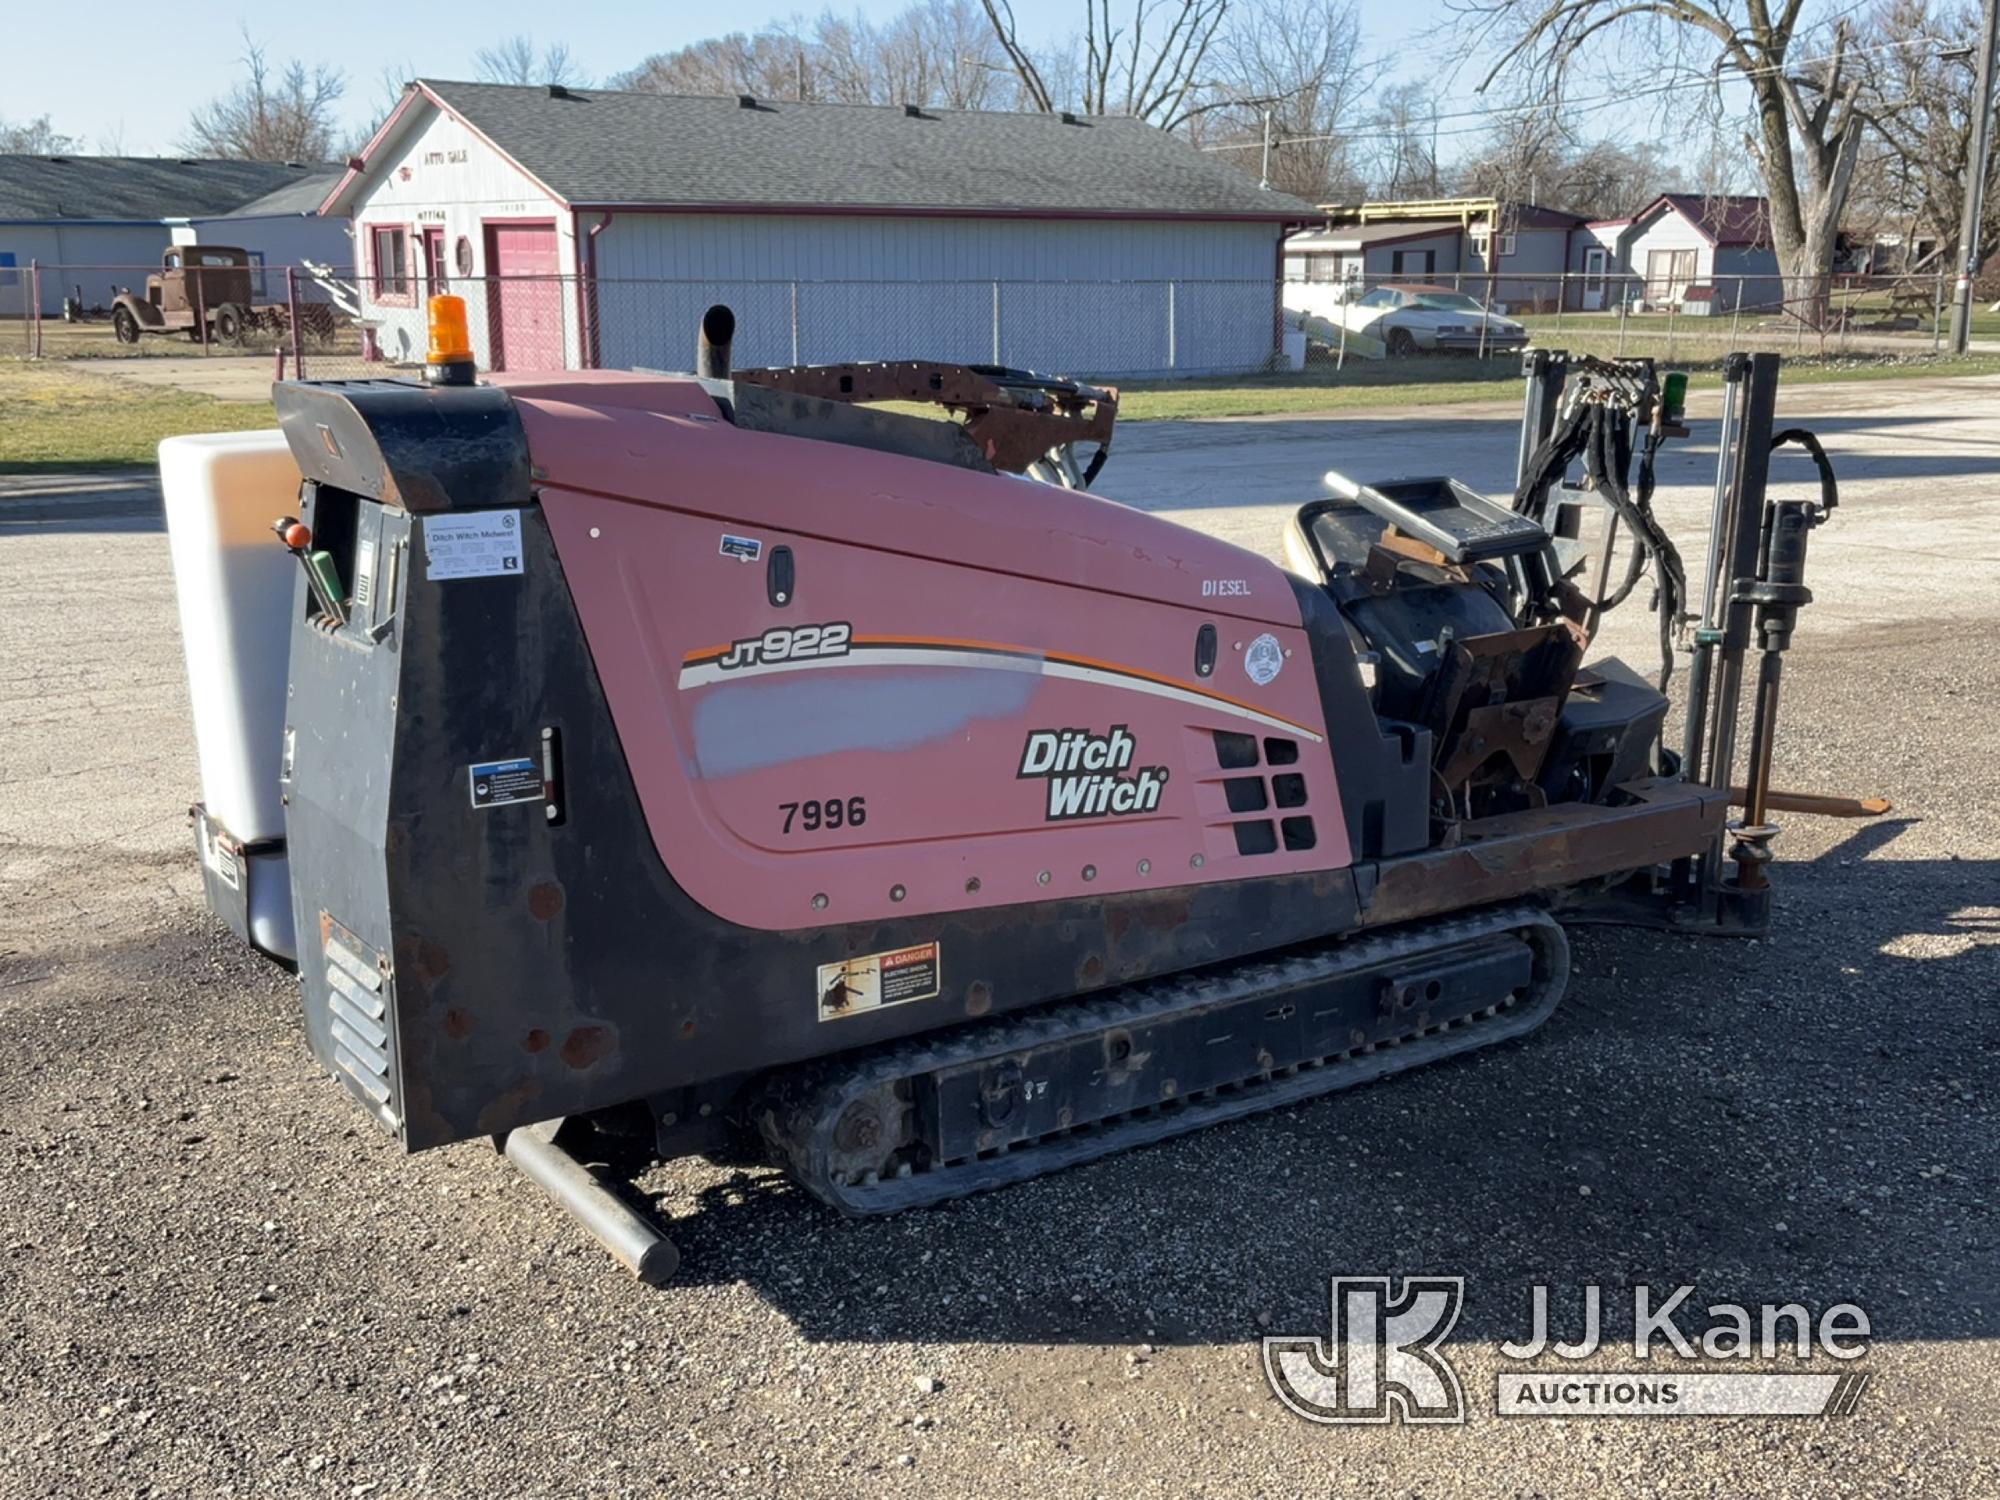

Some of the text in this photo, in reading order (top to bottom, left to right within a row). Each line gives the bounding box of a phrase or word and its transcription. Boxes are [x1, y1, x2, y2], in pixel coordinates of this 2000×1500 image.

[432, 533, 455, 542] Ditch
[456, 532, 480, 540] Witch
[1202, 580, 1251, 596] DIESEL
[720, 622, 851, 668] JT922
[1020, 728, 1134, 775] Ditch
[779, 796, 866, 834] 7996
[895, 949, 932, 965] DANGER
